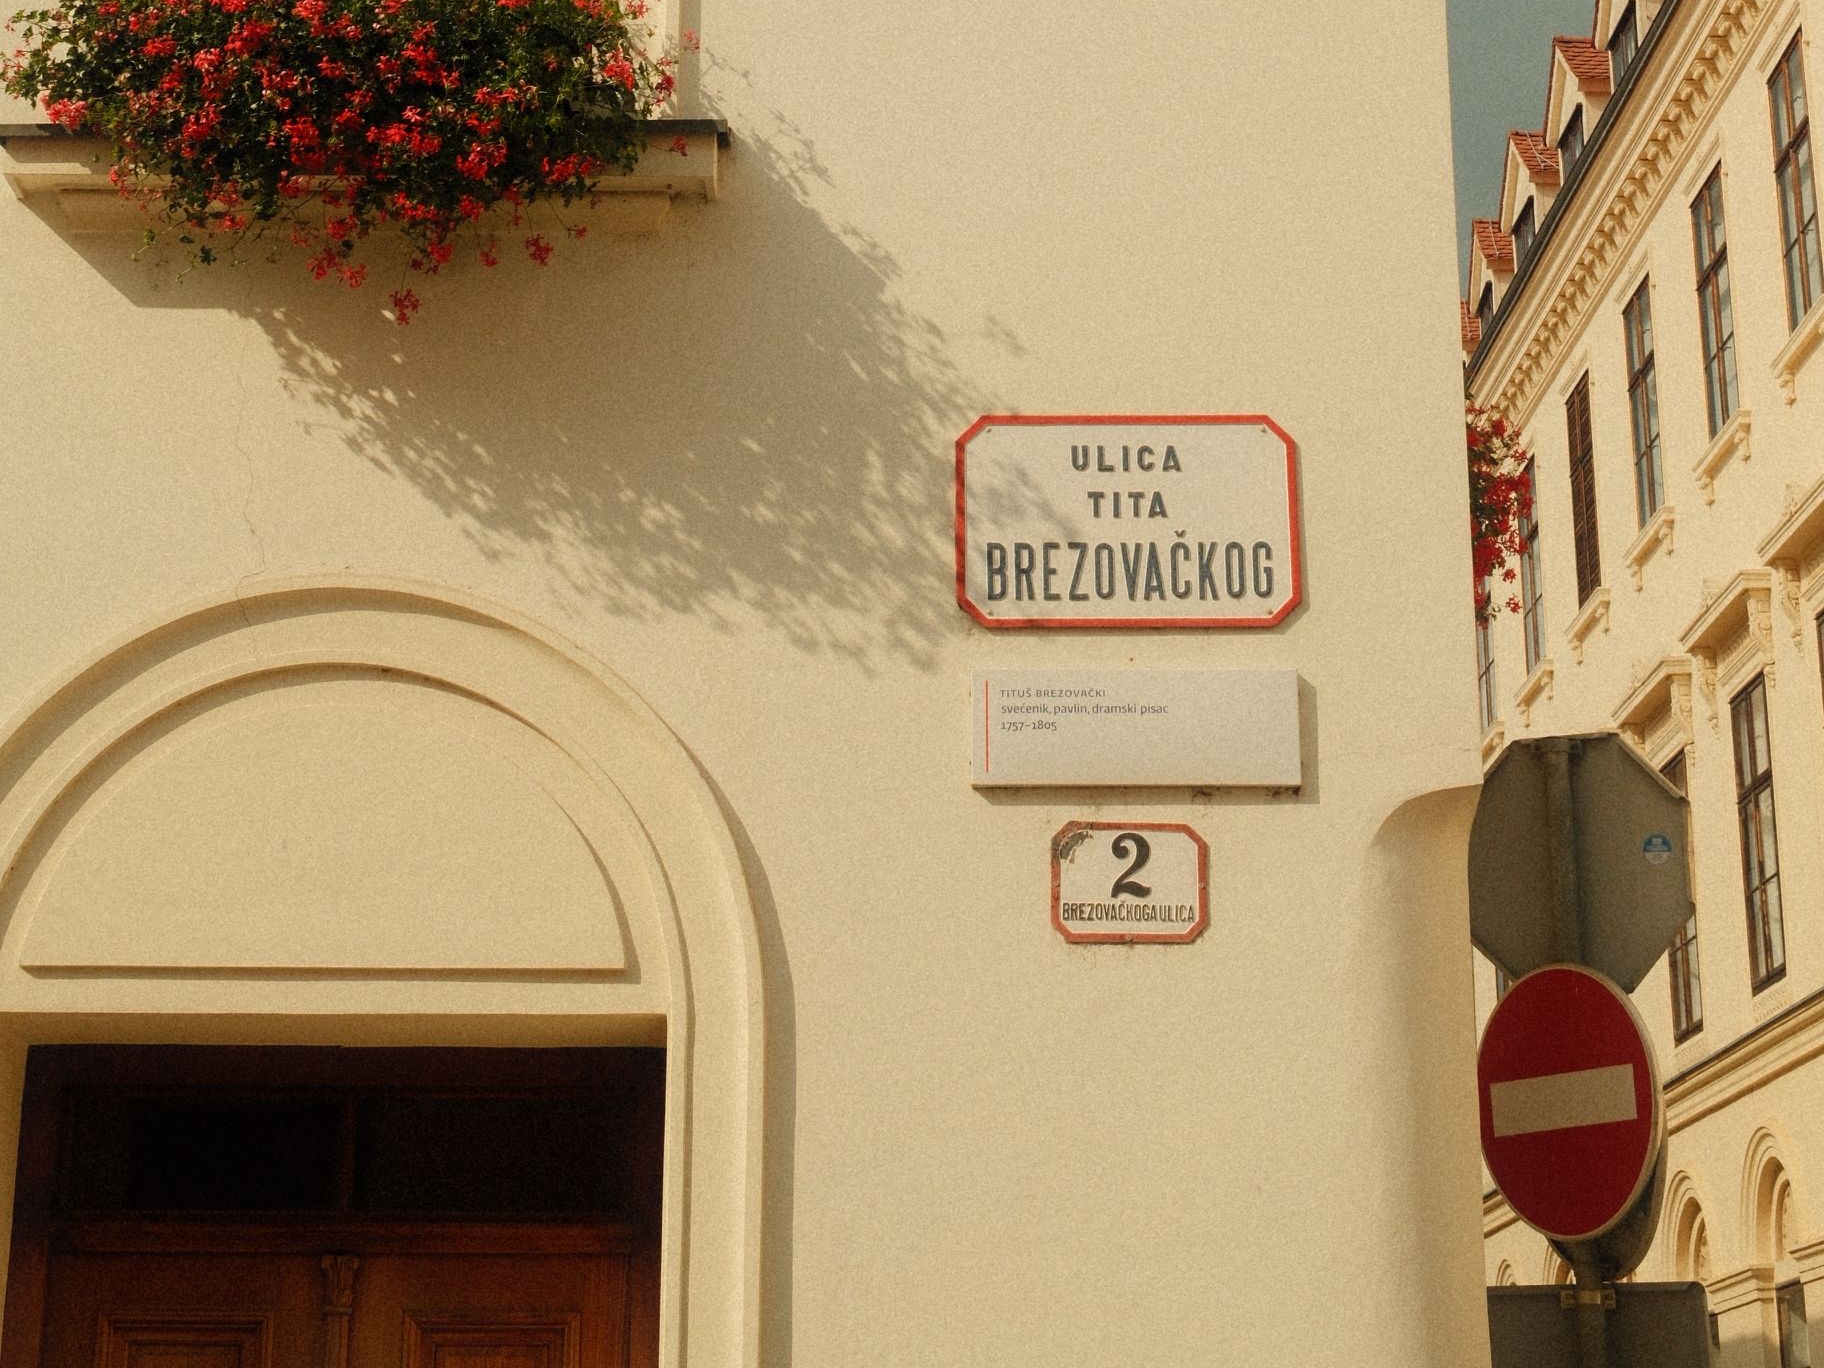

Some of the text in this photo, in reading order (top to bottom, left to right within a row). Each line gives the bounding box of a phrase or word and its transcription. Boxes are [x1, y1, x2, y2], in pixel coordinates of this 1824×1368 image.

[1071, 445, 1182, 472] ULICA
[1087, 491, 1168, 518] TITA
[986, 529, 1273, 601] BREZOVAČKOG
[1001, 702, 1169, 716] svećenik, pavlin, dramski pisac
[1110, 832, 1153, 898] 2
